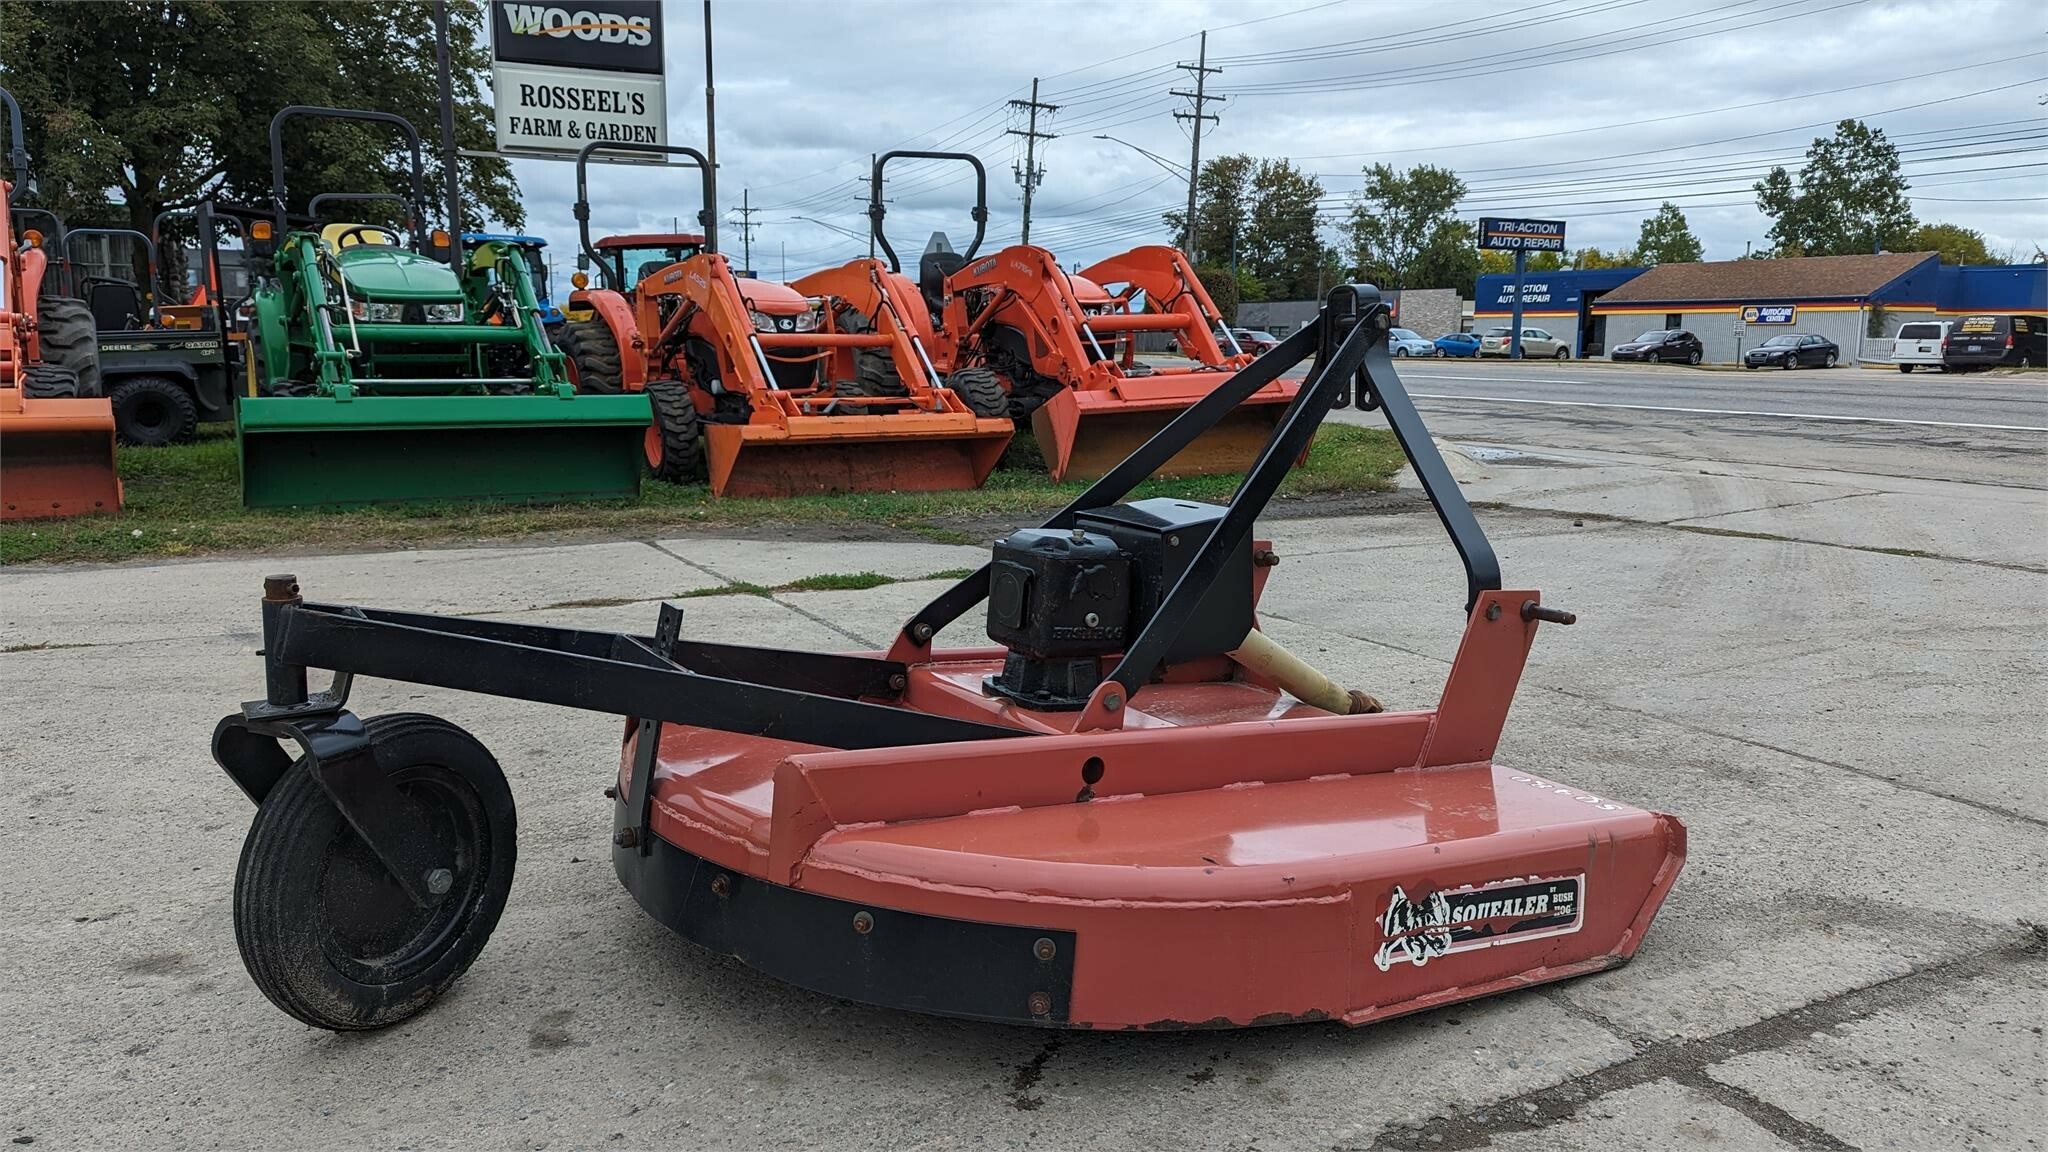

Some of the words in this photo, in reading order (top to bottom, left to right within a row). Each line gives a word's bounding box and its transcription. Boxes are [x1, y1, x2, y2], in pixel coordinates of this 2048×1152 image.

[503, 3, 652, 46] WOODS
[520, 84, 645, 115] ROSSEEL'S
[509, 117, 562, 137] FARM
[567, 121, 581, 139] &
[585, 122, 657, 143] GARDEN
[1490, 236, 1521, 247] AUTO
[1523, 238, 1561, 249] REPAIR
[1497, 295, 1515, 304] AUT
[1522, 294, 1551, 303] REPAIR
[1451, 894, 1549, 925] SQUEALER
[1552, 892, 1574, 903] BUSH
